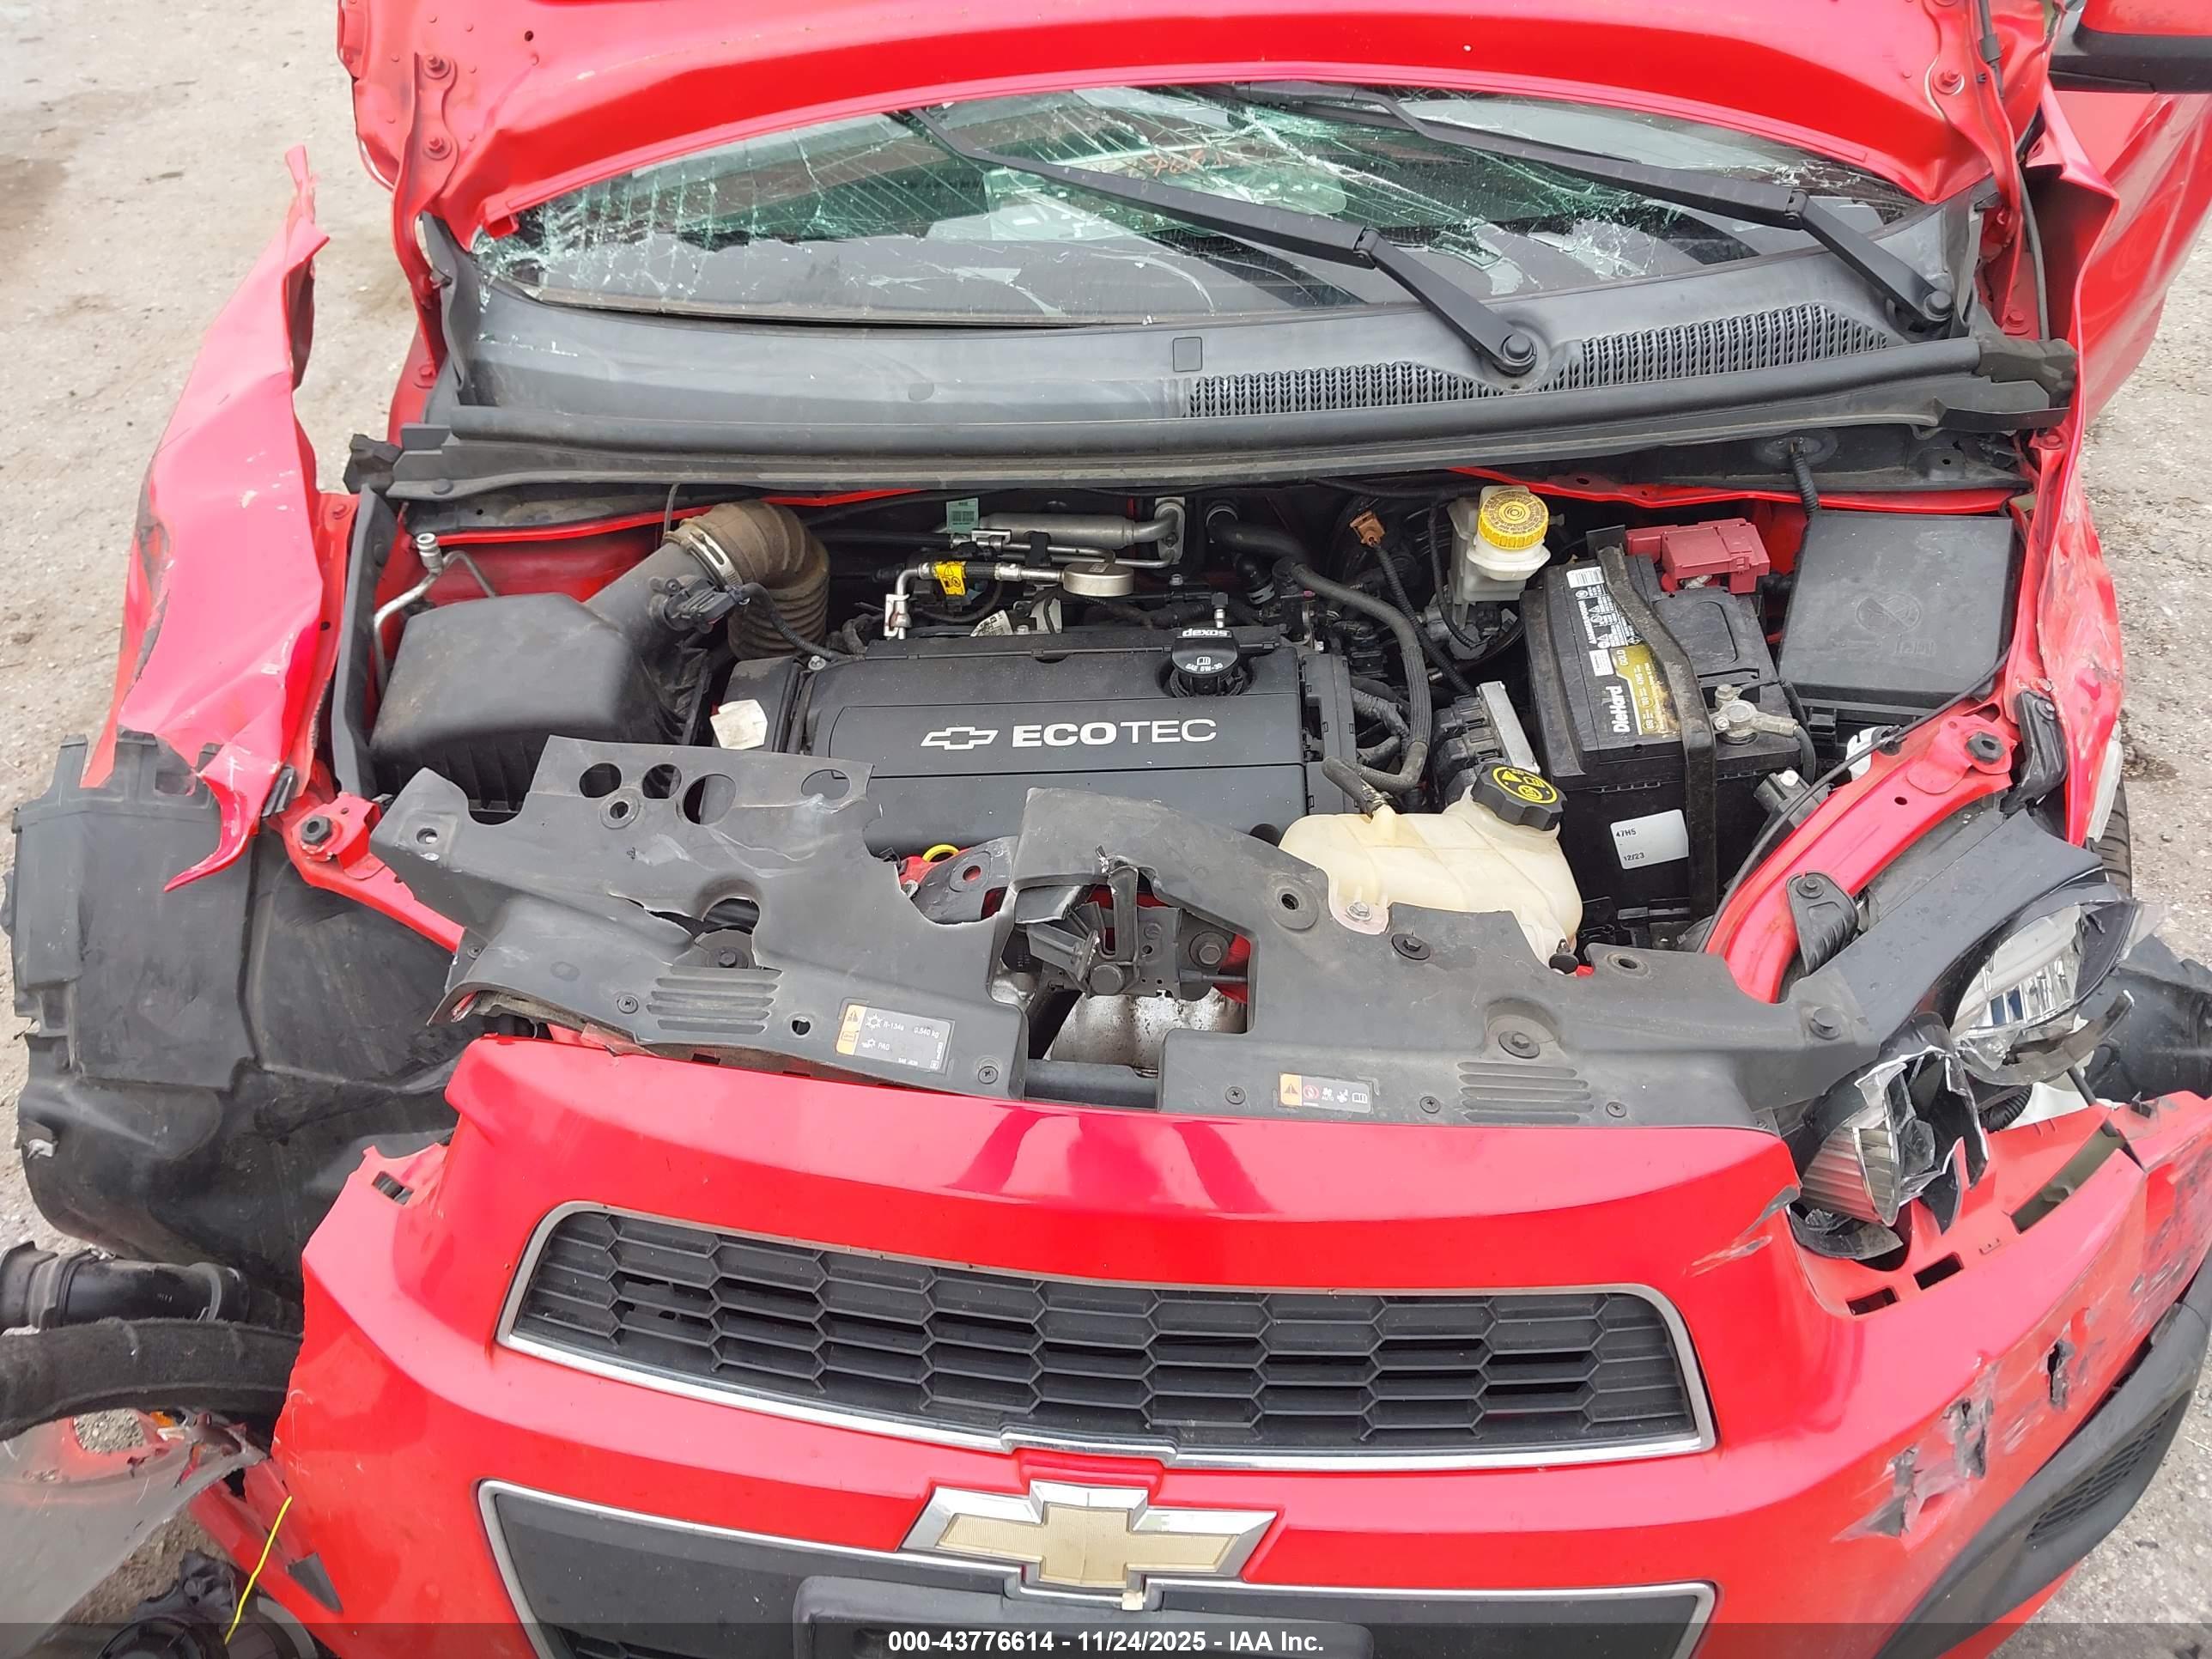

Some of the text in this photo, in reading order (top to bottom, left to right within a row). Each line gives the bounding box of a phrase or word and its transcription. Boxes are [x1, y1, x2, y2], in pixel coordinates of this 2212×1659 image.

[1182, 628, 1231, 636] dexos
[1616, 649, 1629, 666] GOLD
[1605, 685, 1631, 732] DieHard
[1012, 719, 1217, 748] ECOTEC
[1615, 828, 1637, 837] 47H5
[1623, 852, 1645, 861] 12/23
[932, 1029, 940, 1039] kg
